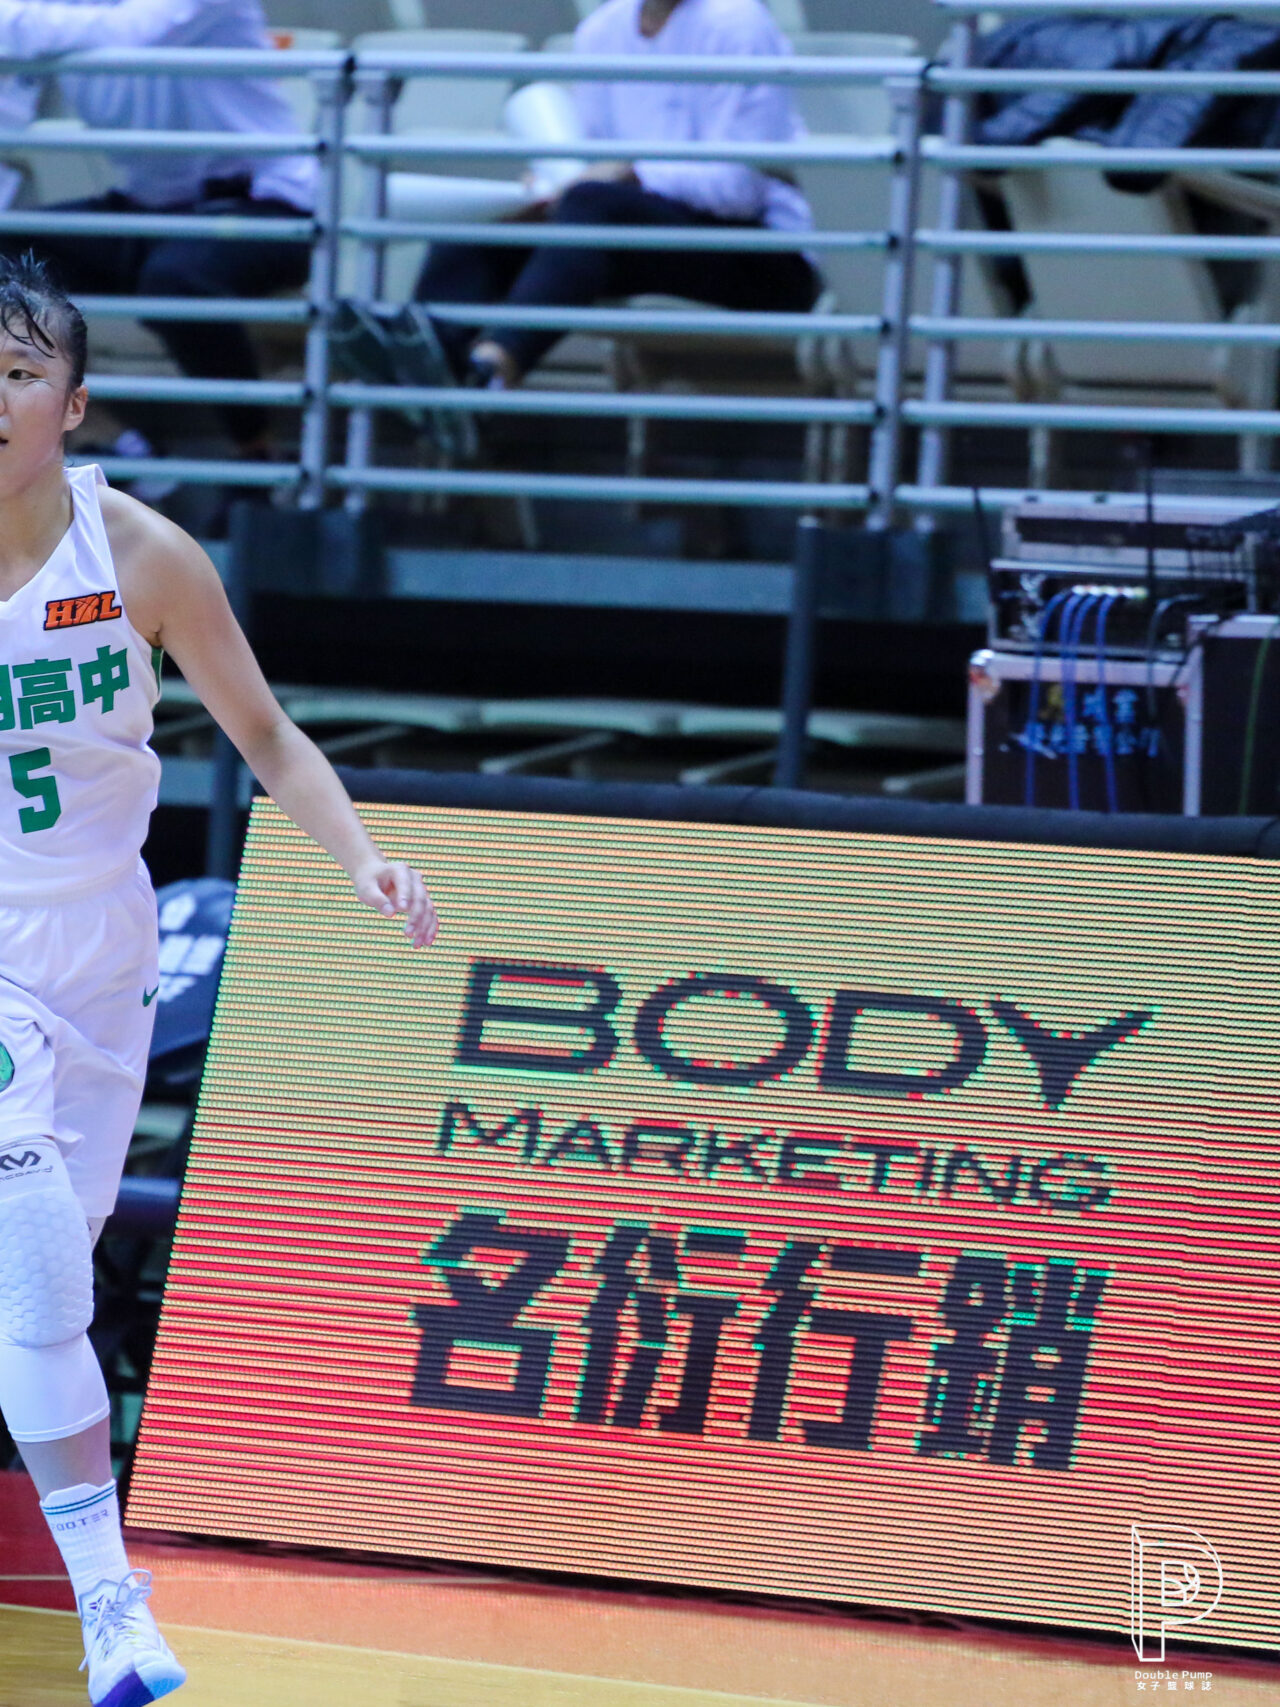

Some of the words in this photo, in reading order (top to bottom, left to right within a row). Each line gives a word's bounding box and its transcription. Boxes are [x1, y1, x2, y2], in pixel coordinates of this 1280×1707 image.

[43, 591, 122, 630] HBL
[8, 747, 62, 834] 5
[455, 959, 1160, 1111] BODY
[437, 1099, 1113, 1211] MARKETING
[410, 1209, 1108, 1470] 名衍行銷
